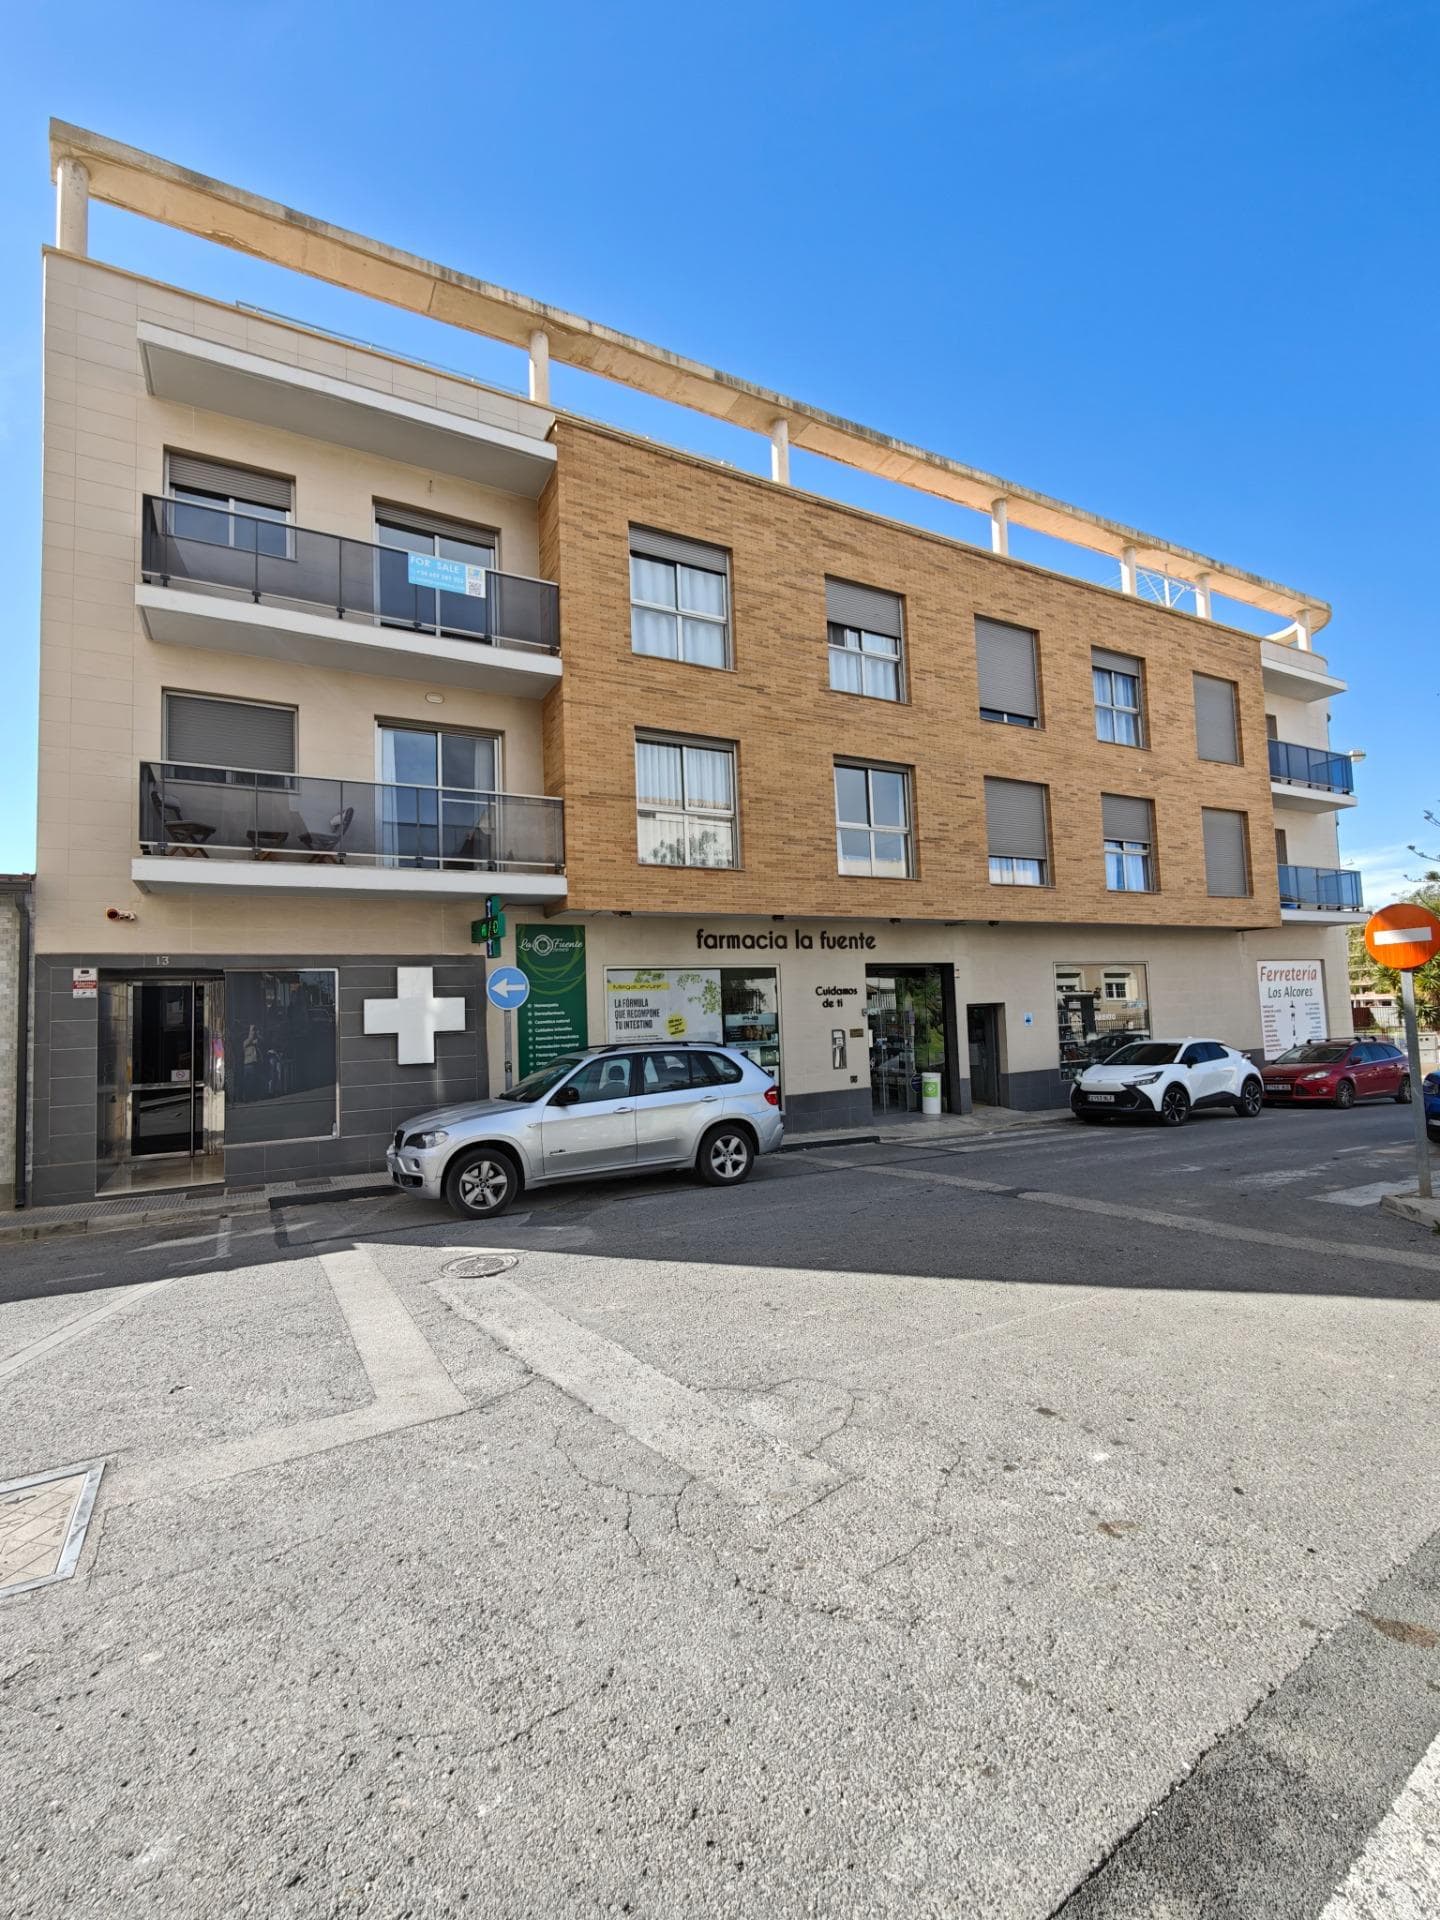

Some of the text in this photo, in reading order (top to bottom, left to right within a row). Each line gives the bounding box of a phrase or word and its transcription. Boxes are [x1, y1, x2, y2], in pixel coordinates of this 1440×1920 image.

[410, 555, 460, 573] FOR SALE
[518, 937, 583, 951] La Fuente
[696, 929, 877, 950] farmacia la fuente
[156, 956, 169, 966] 13
[1260, 964, 1317, 982] Ferretería
[815, 986, 858, 996] Cuidamos
[1268, 986, 1313, 998] Los Alcores
[614, 997, 648, 1008] LA FÓRMULA
[822, 999, 843, 1008] de ti
[615, 1008, 660, 1019] QUE RECOMPONE
[615, 1020, 653, 1030] TU INTESTINO
